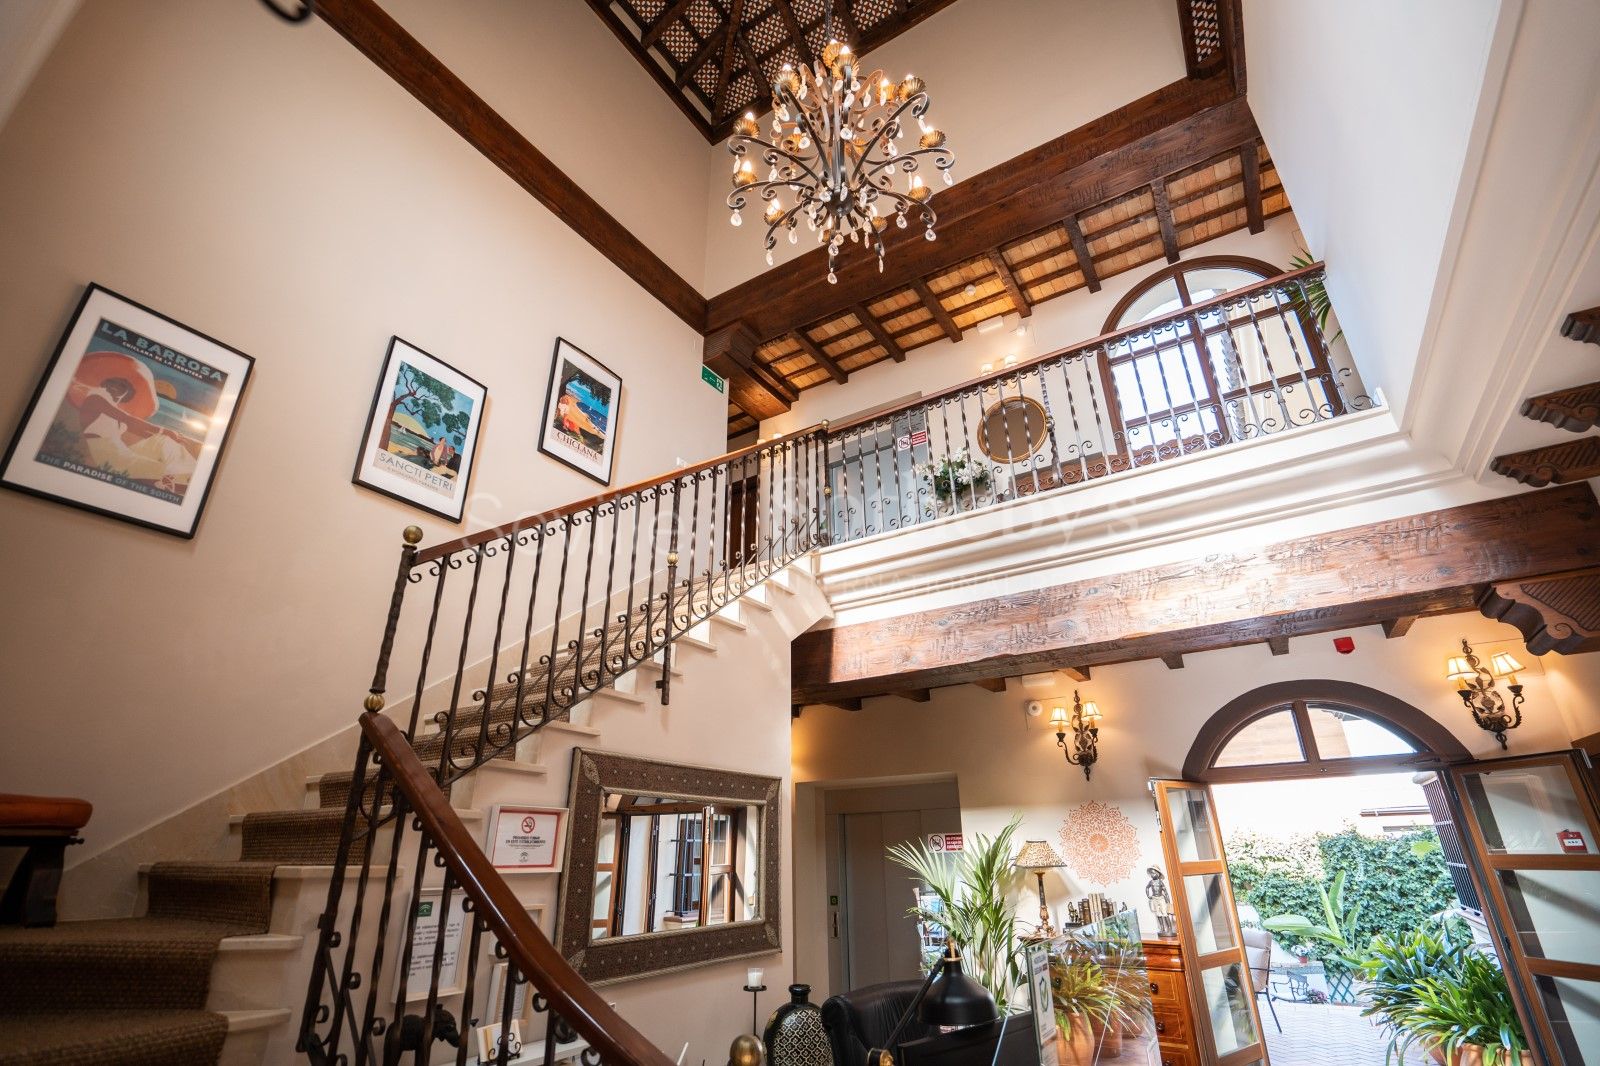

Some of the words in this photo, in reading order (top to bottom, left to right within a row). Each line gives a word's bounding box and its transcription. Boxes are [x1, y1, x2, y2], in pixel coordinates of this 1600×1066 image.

[101, 322, 129, 341] LA
[135, 337, 223, 382] BARROSA
[557, 431, 598, 460] CHICLANA
[39, 453, 61, 466] THE
[63, 461, 113, 482] PARADISE
[115, 477, 128, 486] OF
[130, 481, 147, 493] THE
[149, 488, 180, 502] SOUTH
[379, 452, 422, 478] SANCTI
[424, 472, 453, 491] PETRI
